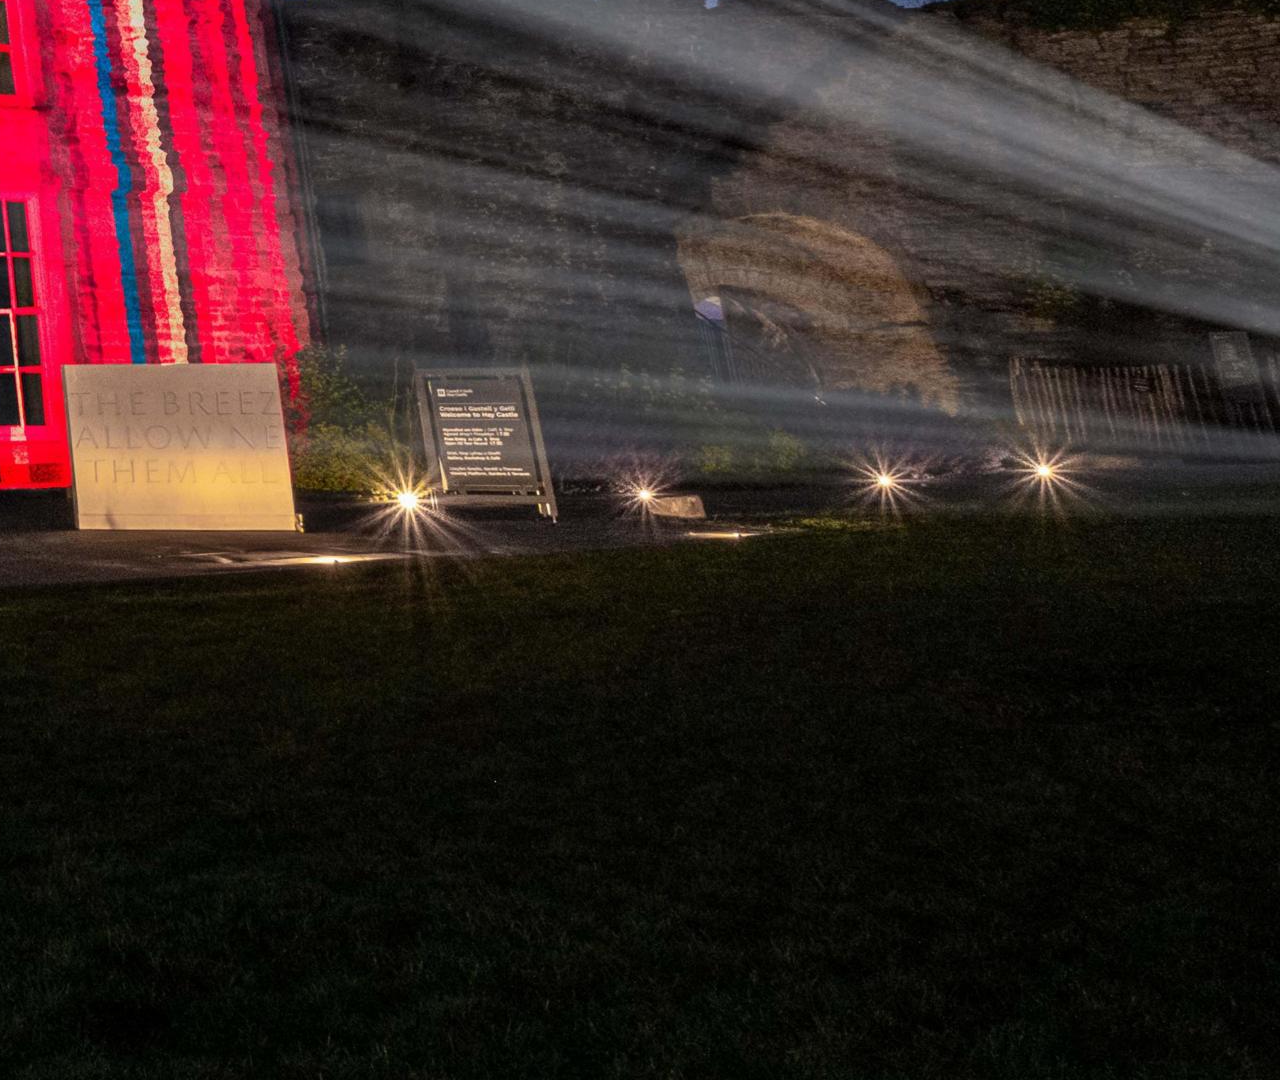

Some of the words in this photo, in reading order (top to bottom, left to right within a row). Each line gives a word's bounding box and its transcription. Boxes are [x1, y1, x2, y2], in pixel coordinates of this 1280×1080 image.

[71, 392, 146, 416] THE
[162, 391, 281, 416] BREEZ
[75, 425, 212, 450] ALLOW
[232, 424, 281, 450] NE
[85, 459, 197, 484] THEM
[211, 458, 284, 484] ALL
